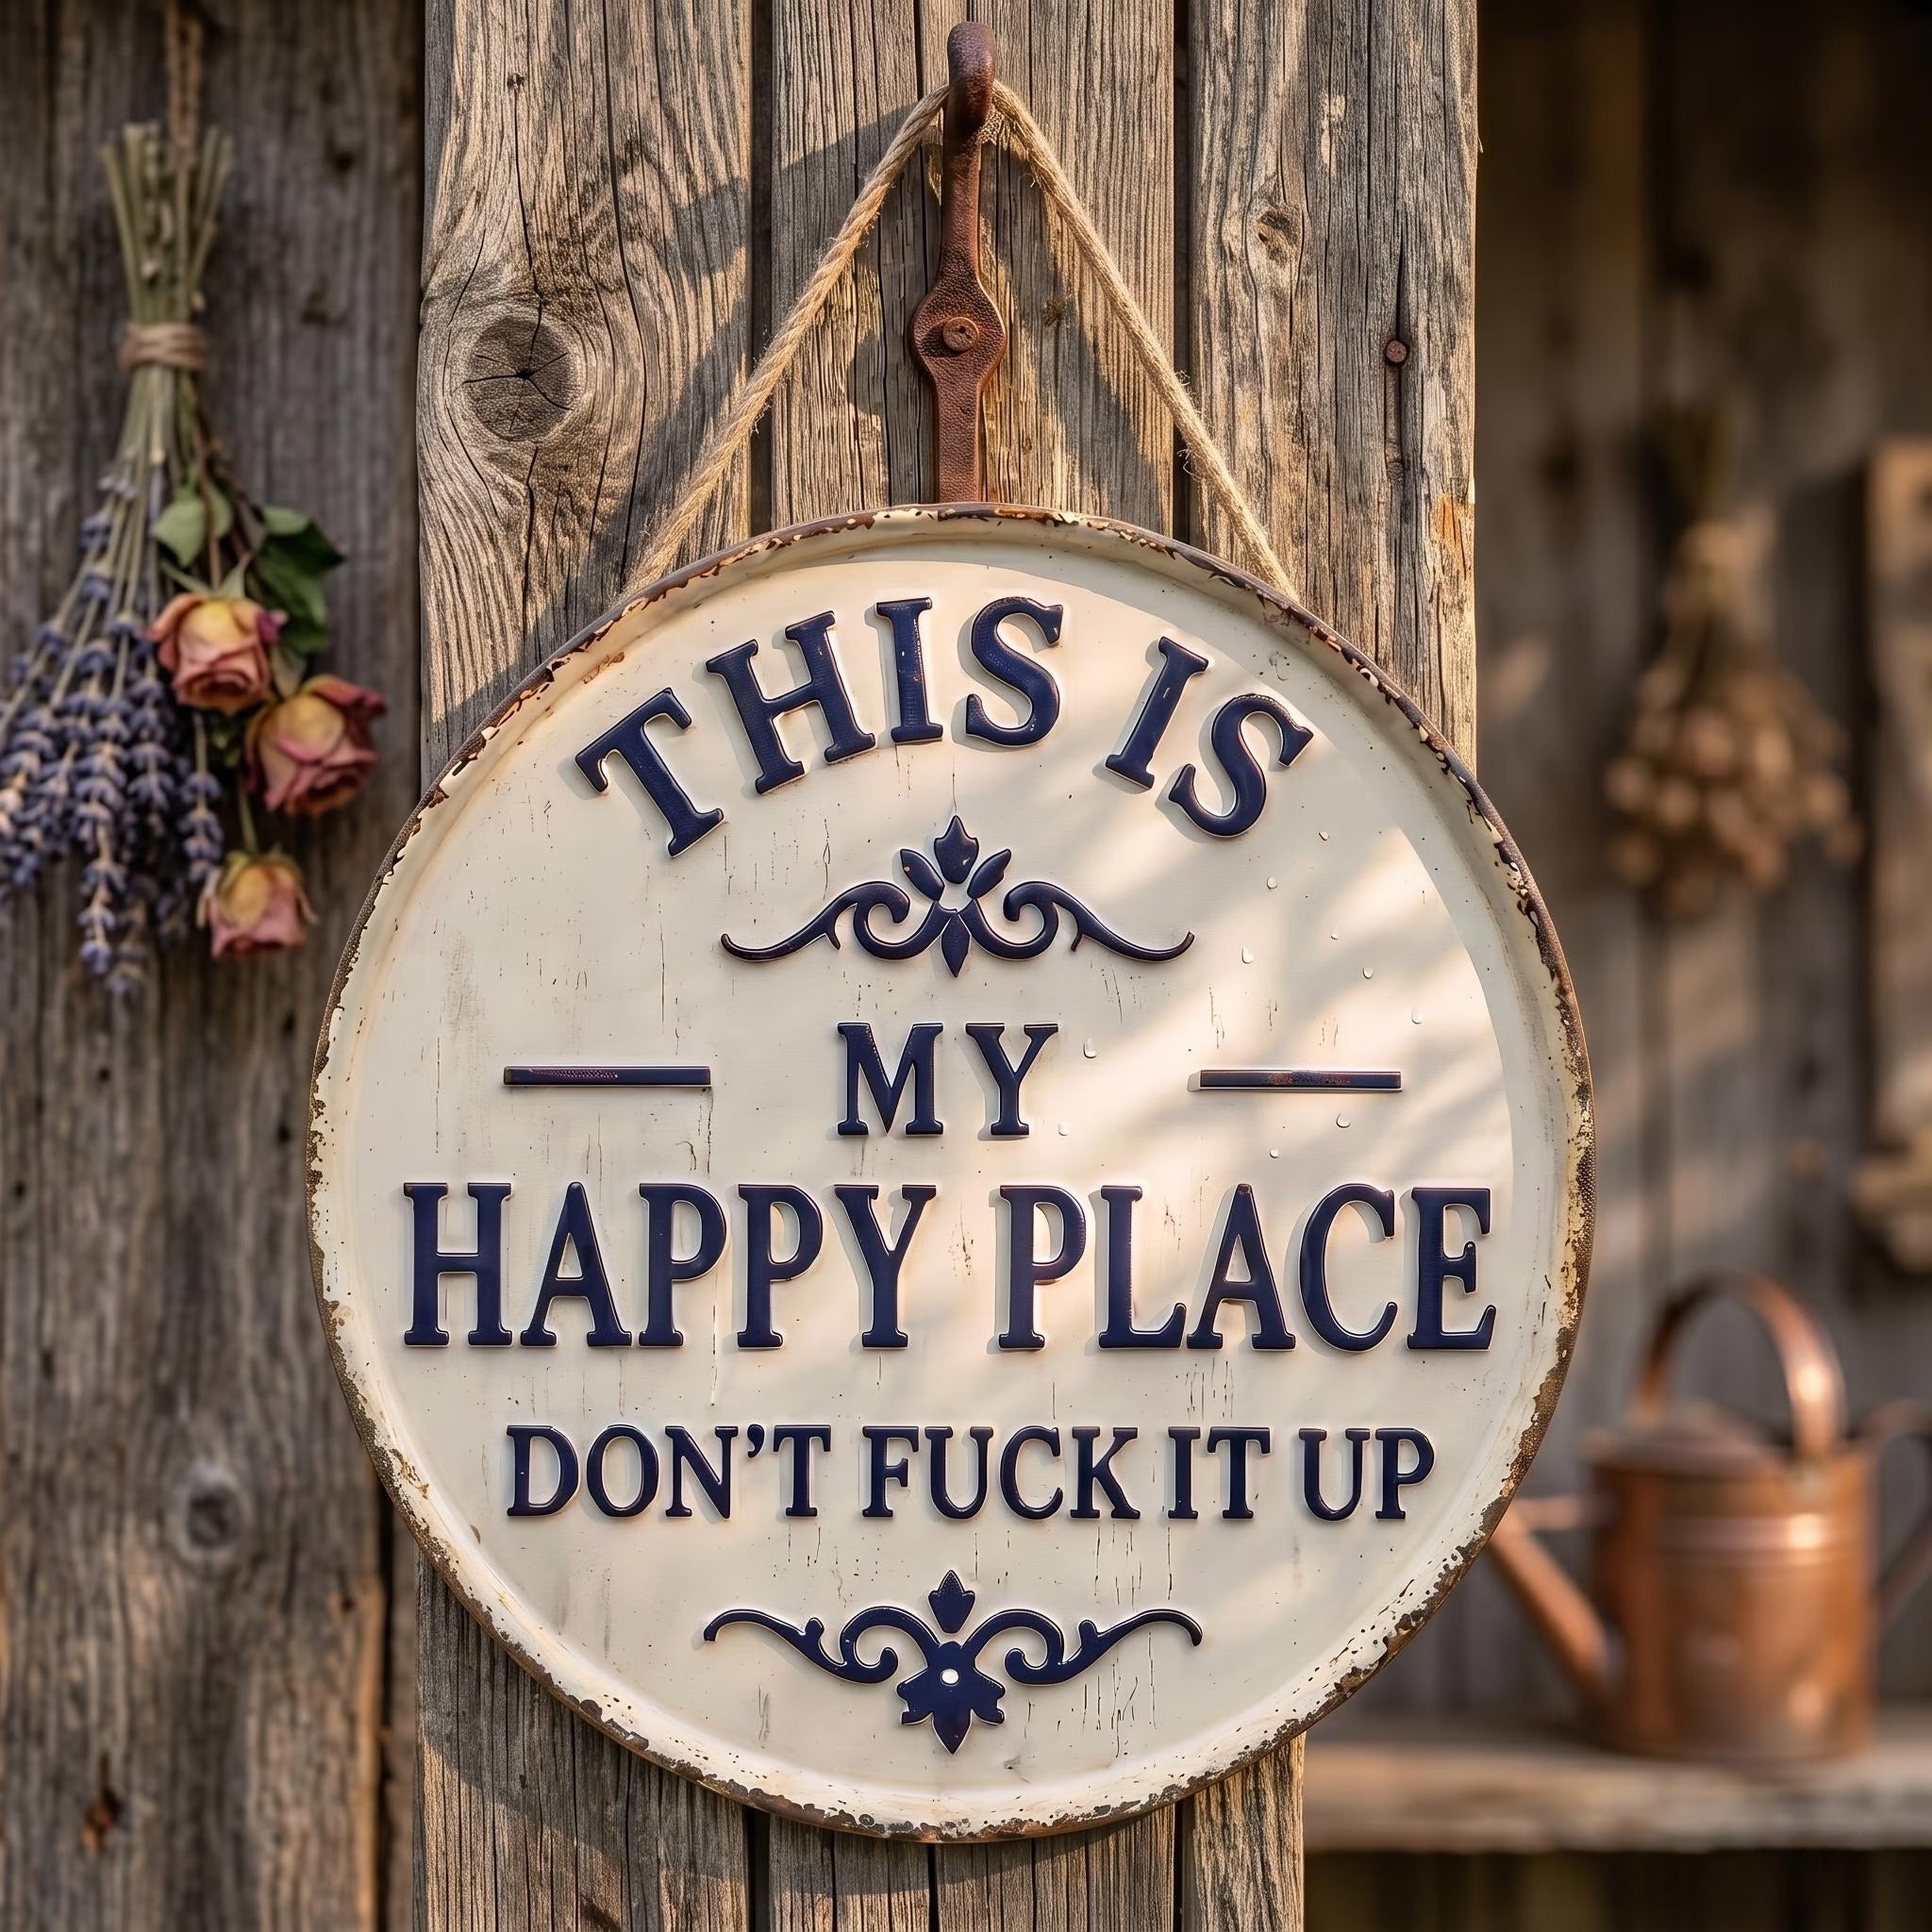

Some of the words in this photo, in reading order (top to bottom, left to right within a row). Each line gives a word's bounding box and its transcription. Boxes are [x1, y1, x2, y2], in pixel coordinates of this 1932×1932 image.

[575, 596, 1064, 857] THIS
[1105, 636, 1314, 838] IS
[837, 1022, 1058, 1136] MY
[404, 1183, 937, 1349] HAPPY
[996, 1184, 1496, 1351] PLACE
[507, 1424, 831, 1518] DON’T
[862, 1425, 1139, 1519] FUCK
[1168, 1427, 1270, 1520] IT
[1300, 1428, 1435, 1521] UP
